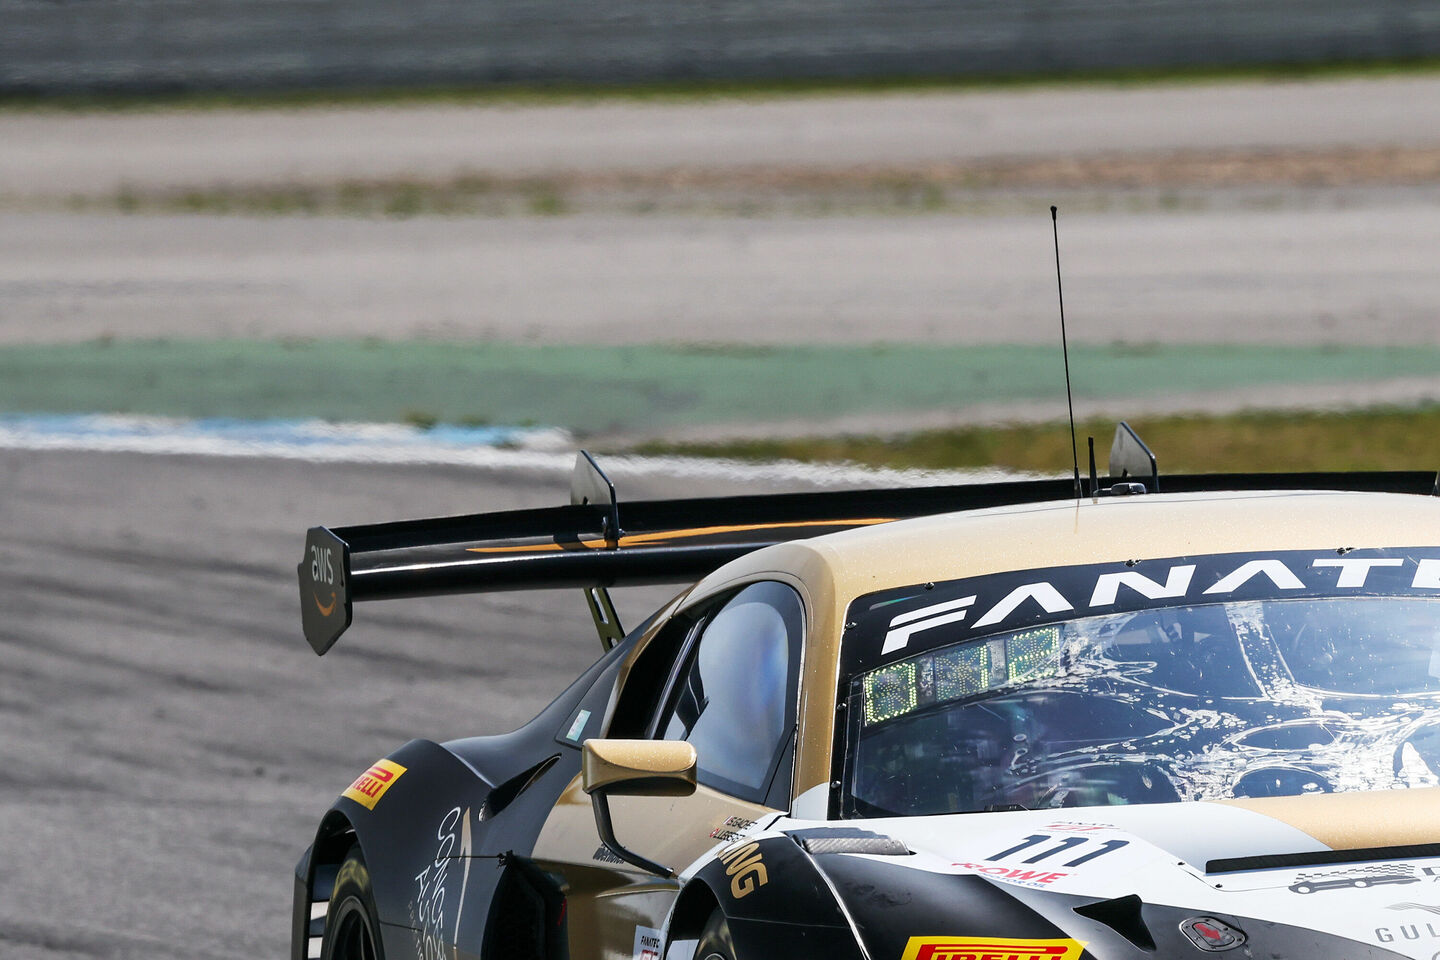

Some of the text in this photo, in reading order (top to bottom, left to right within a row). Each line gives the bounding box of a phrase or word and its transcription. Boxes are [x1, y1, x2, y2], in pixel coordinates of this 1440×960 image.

[311, 544, 333, 584] aws
[352, 765, 394, 798] RELLI
[984, 834, 1130, 867] 111
[717, 842, 768, 899] ING
[952, 862, 1069, 883] ROWE
